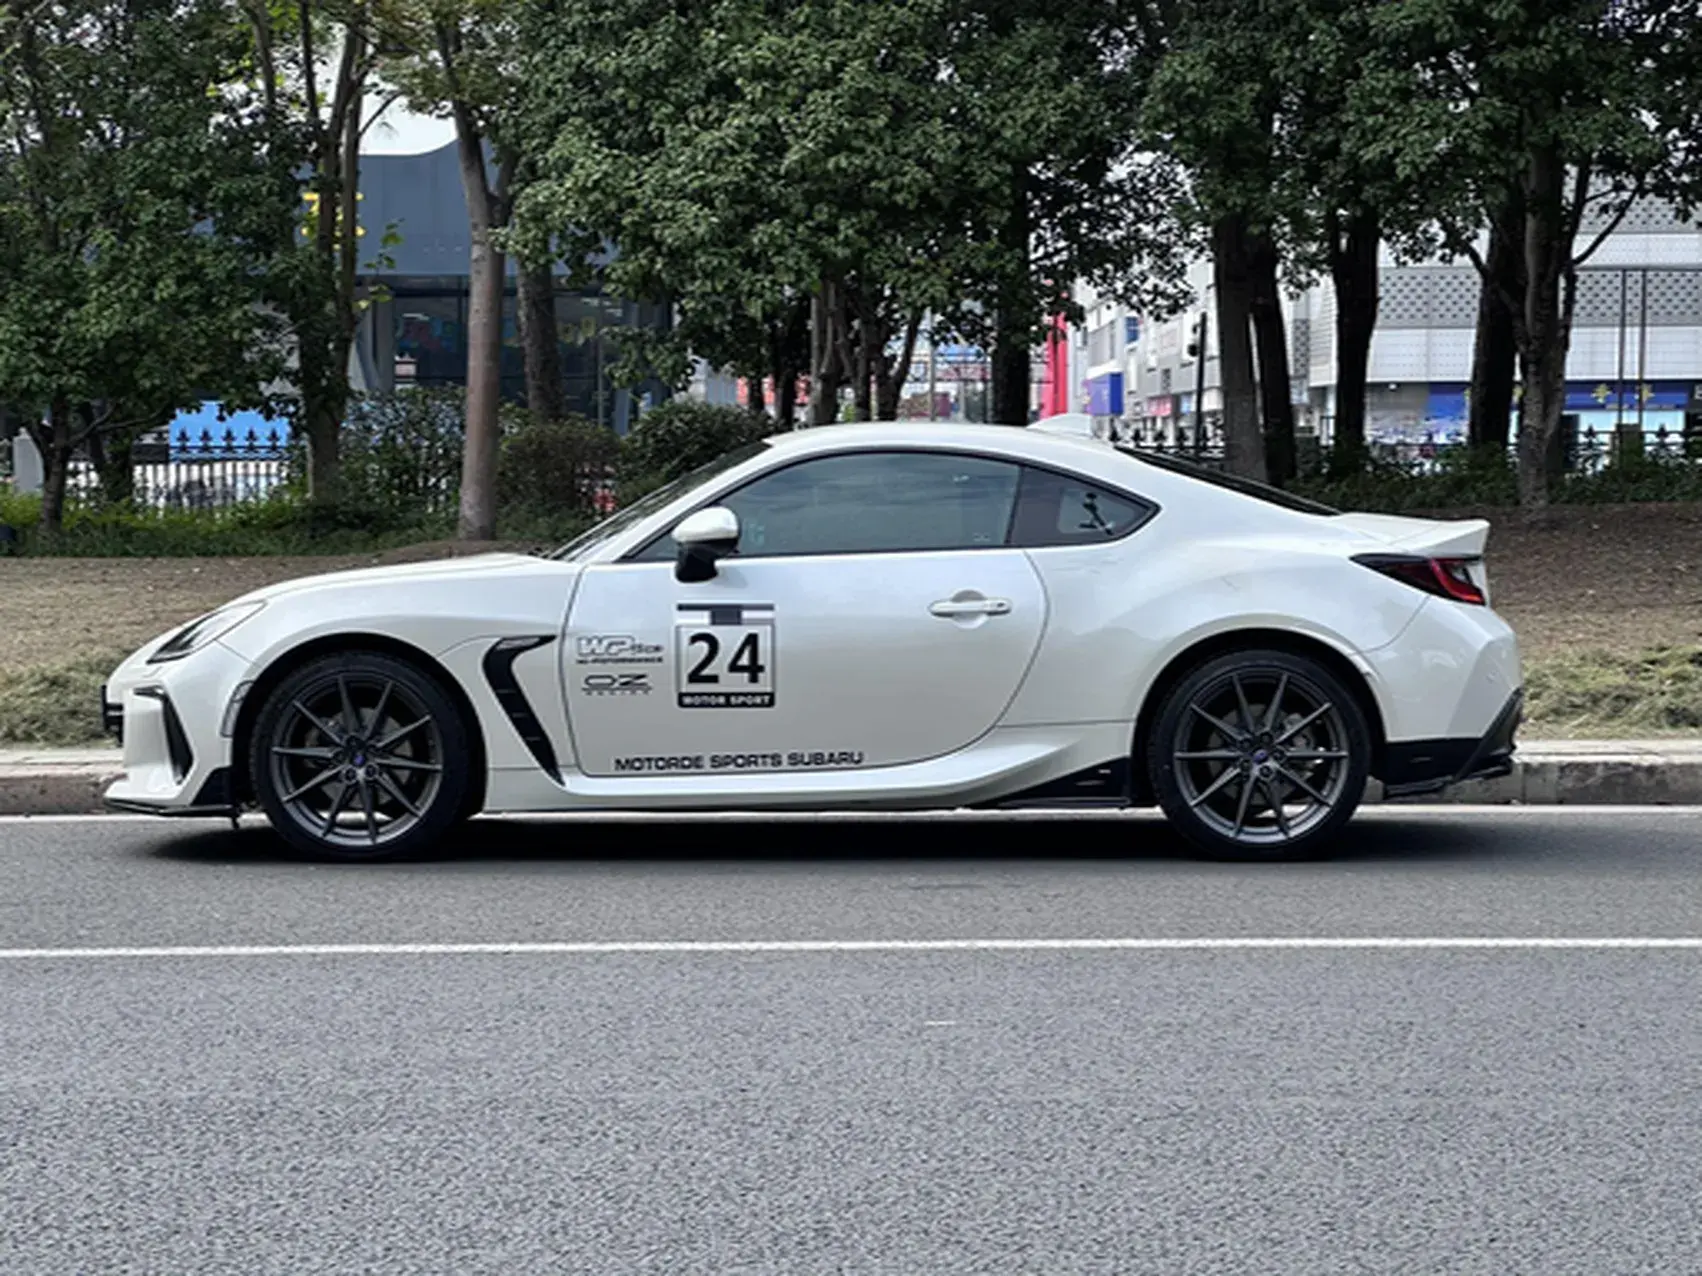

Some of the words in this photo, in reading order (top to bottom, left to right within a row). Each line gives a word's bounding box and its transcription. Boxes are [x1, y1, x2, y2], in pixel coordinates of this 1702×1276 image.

[687, 632, 765, 684] 24
[683, 695, 725, 705] MOTOR
[729, 695, 770, 705] SPORT
[709, 753, 783, 769] SPORTS
[787, 751, 864, 767] SUBARU
